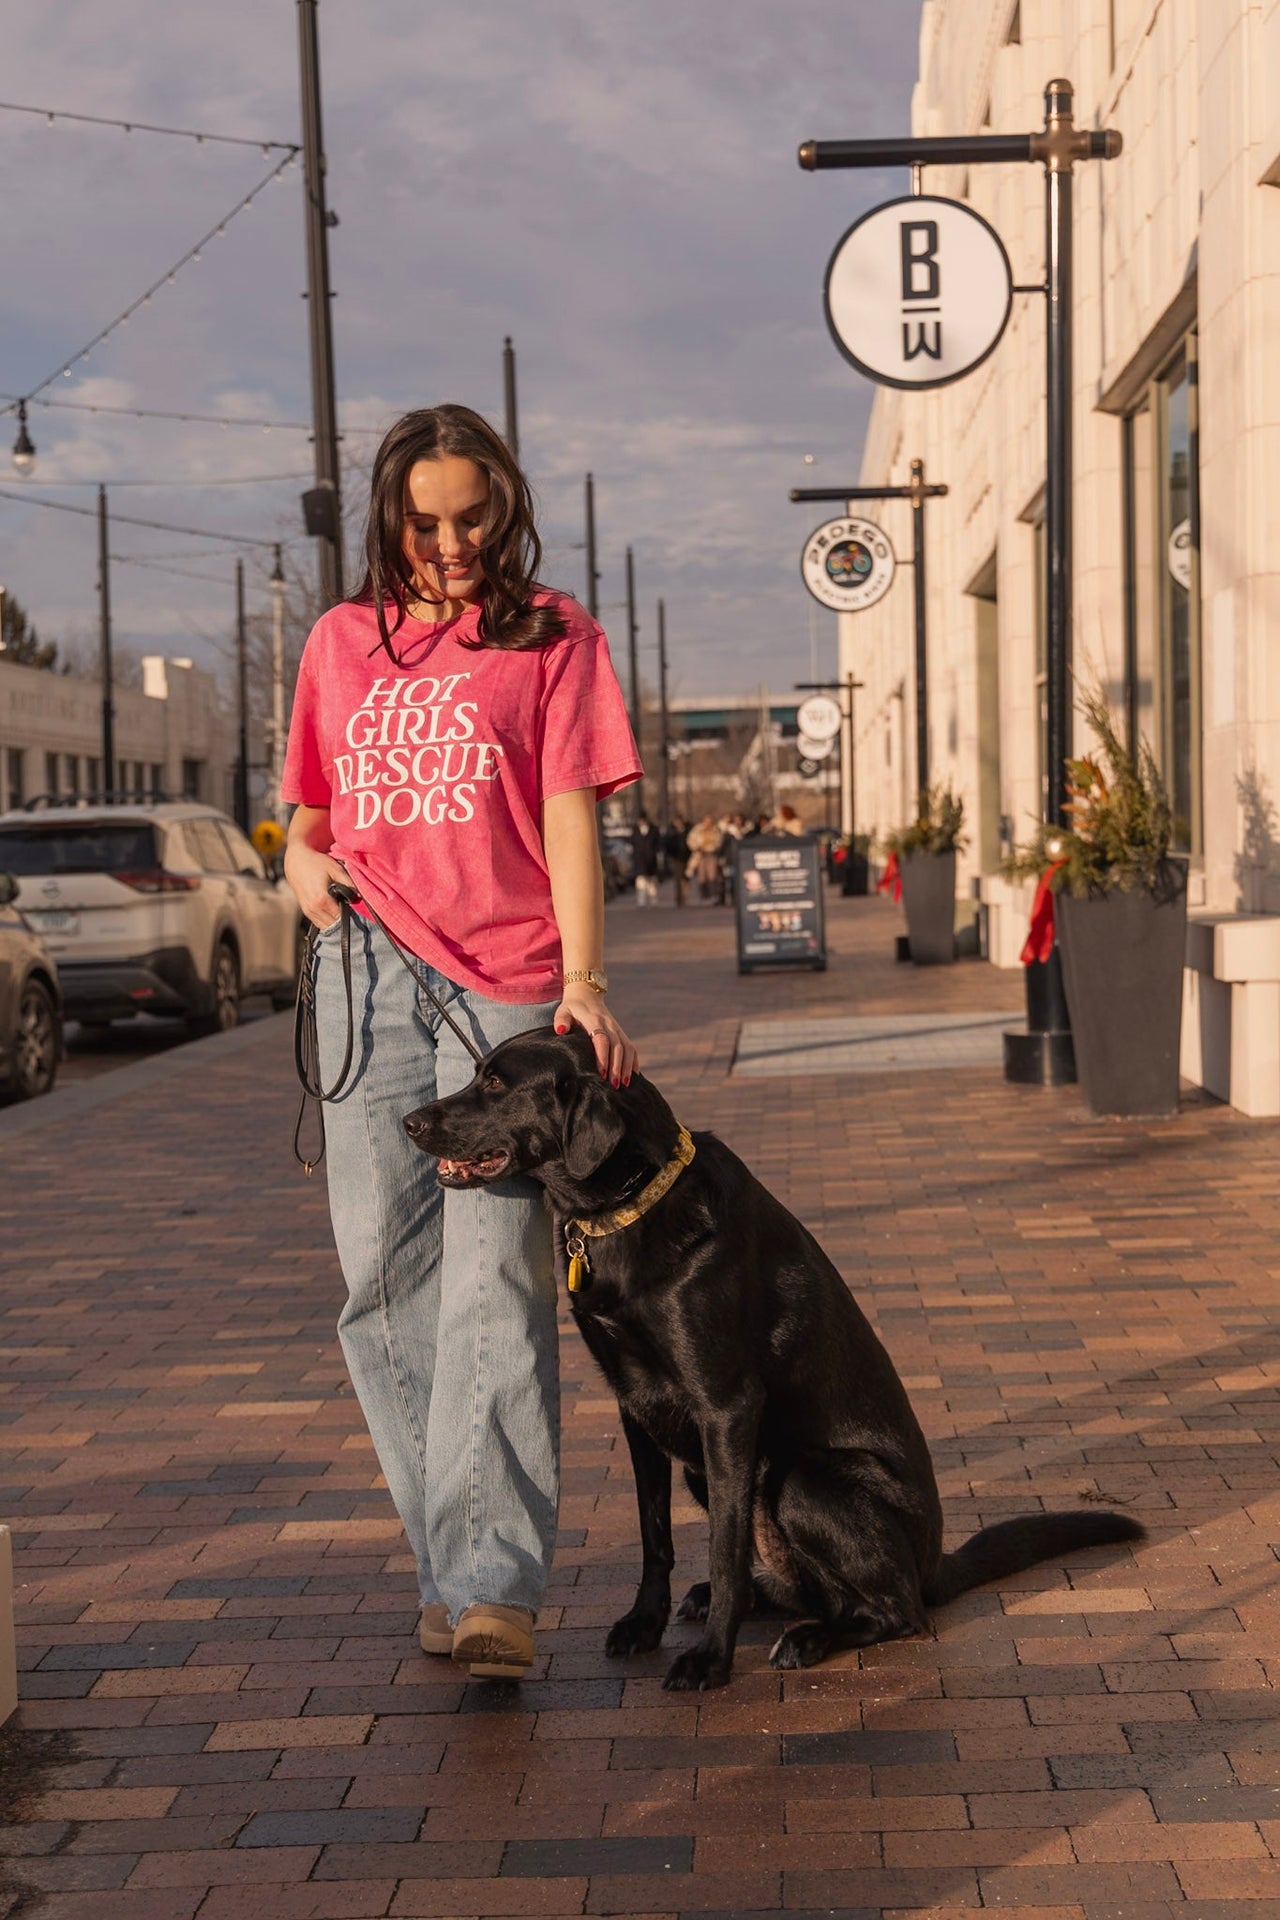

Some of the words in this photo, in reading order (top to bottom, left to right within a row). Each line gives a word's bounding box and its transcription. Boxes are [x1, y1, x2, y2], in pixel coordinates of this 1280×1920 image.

[901, 220, 940, 300] B
[361, 672, 471, 708] HOT
[346, 702, 479, 749] GIRLS
[334, 743, 504, 795] RESCUE
[354, 783, 477, 830] DOGS
